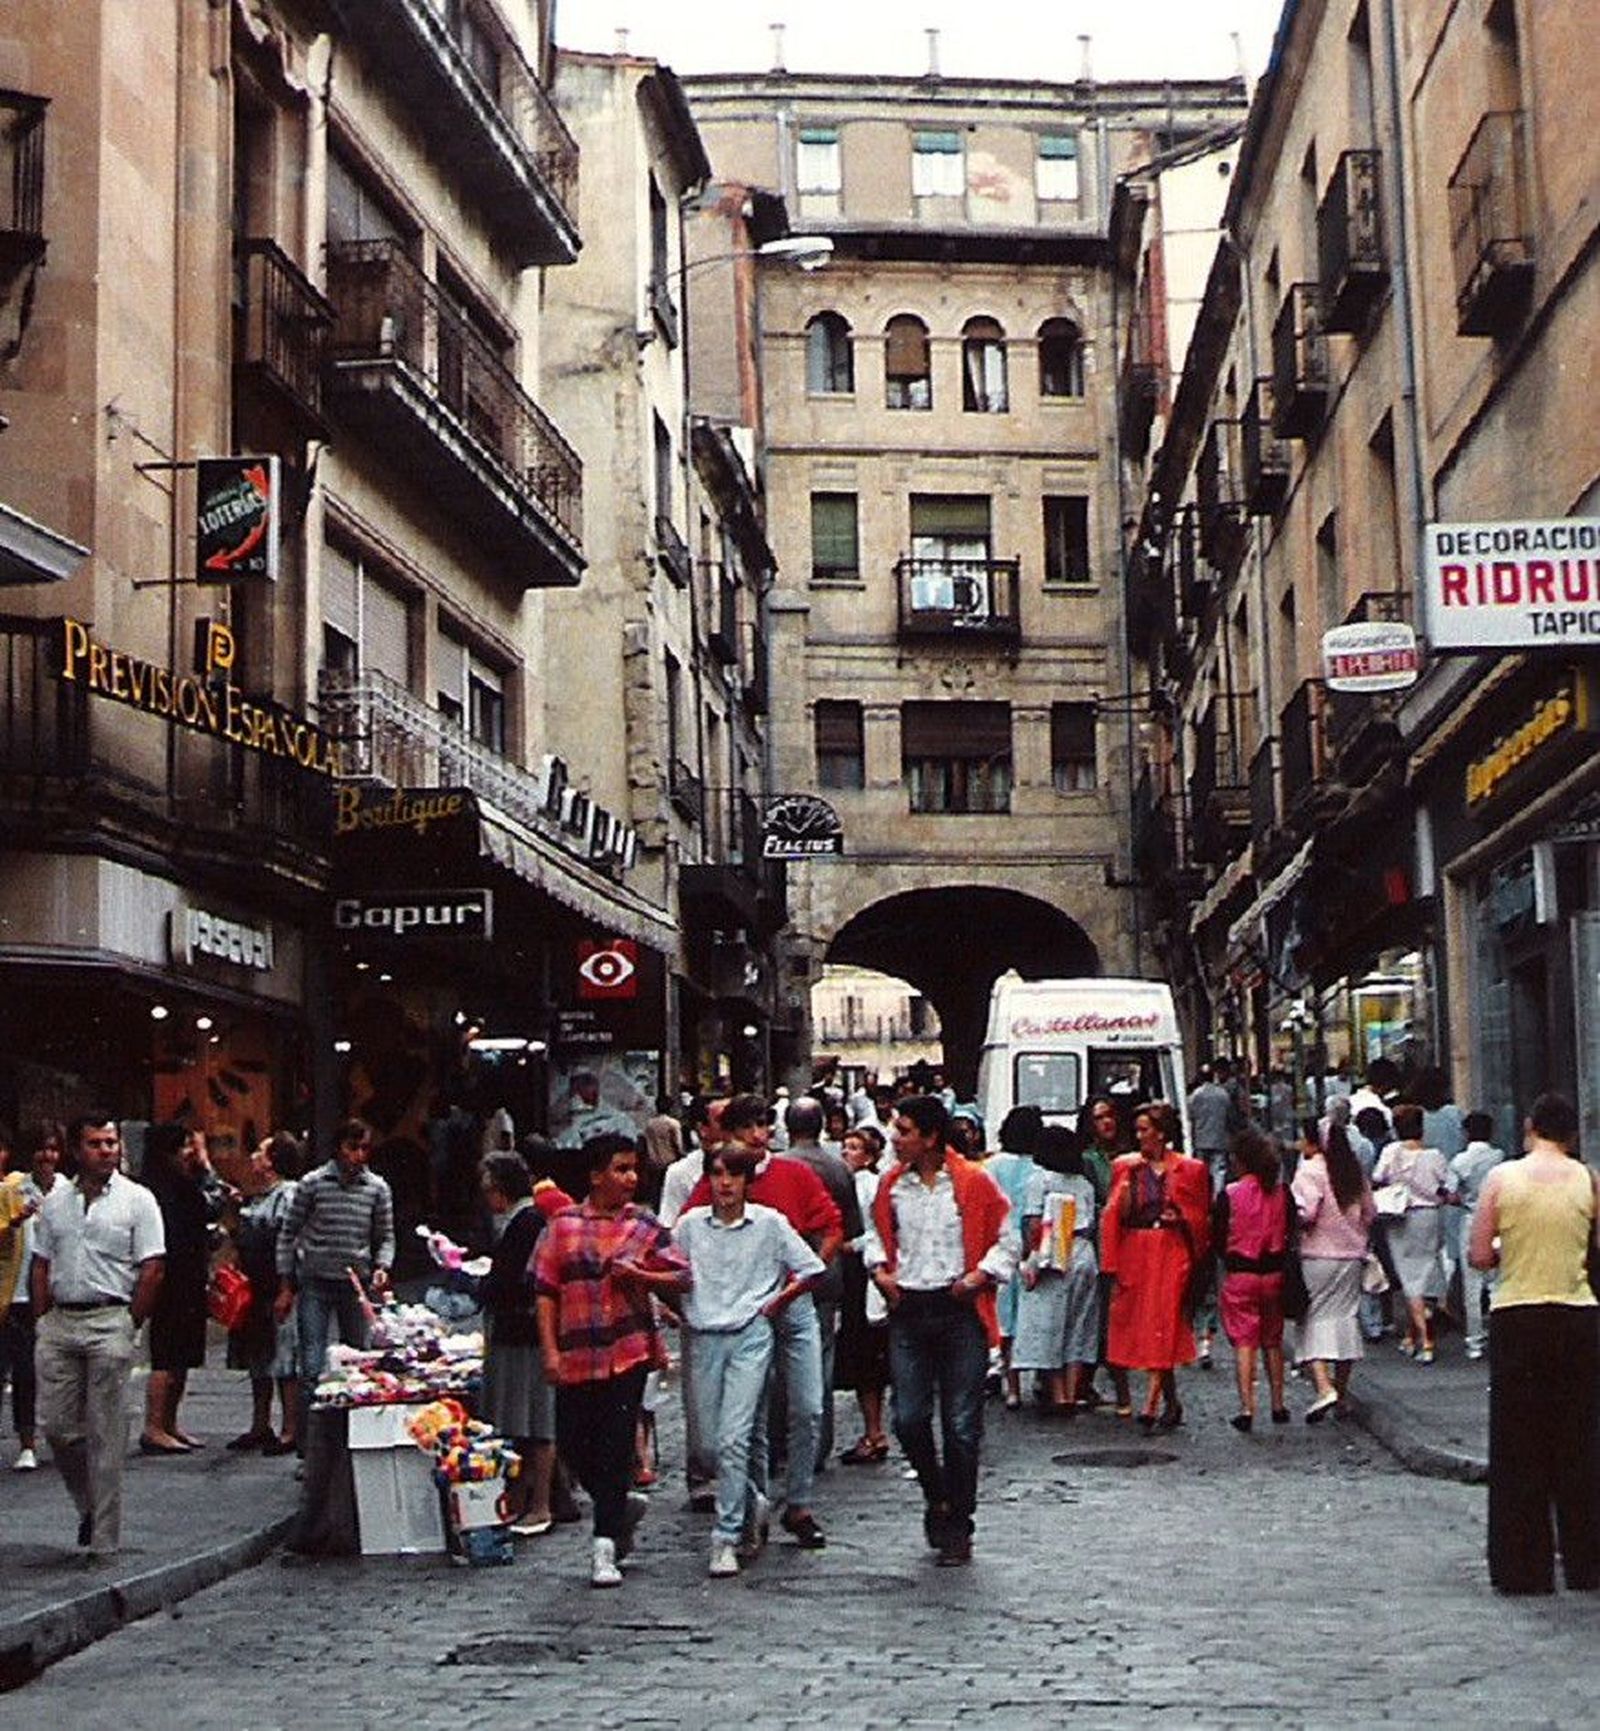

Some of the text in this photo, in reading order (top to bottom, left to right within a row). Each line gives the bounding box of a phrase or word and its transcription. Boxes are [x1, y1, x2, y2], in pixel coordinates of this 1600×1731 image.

[1436, 526, 1600, 556] DECORACIO
[1439, 560, 1600, 606] RIDRU
[63, 617, 219, 732] PREVISION
[335, 785, 463, 835] Boutique
